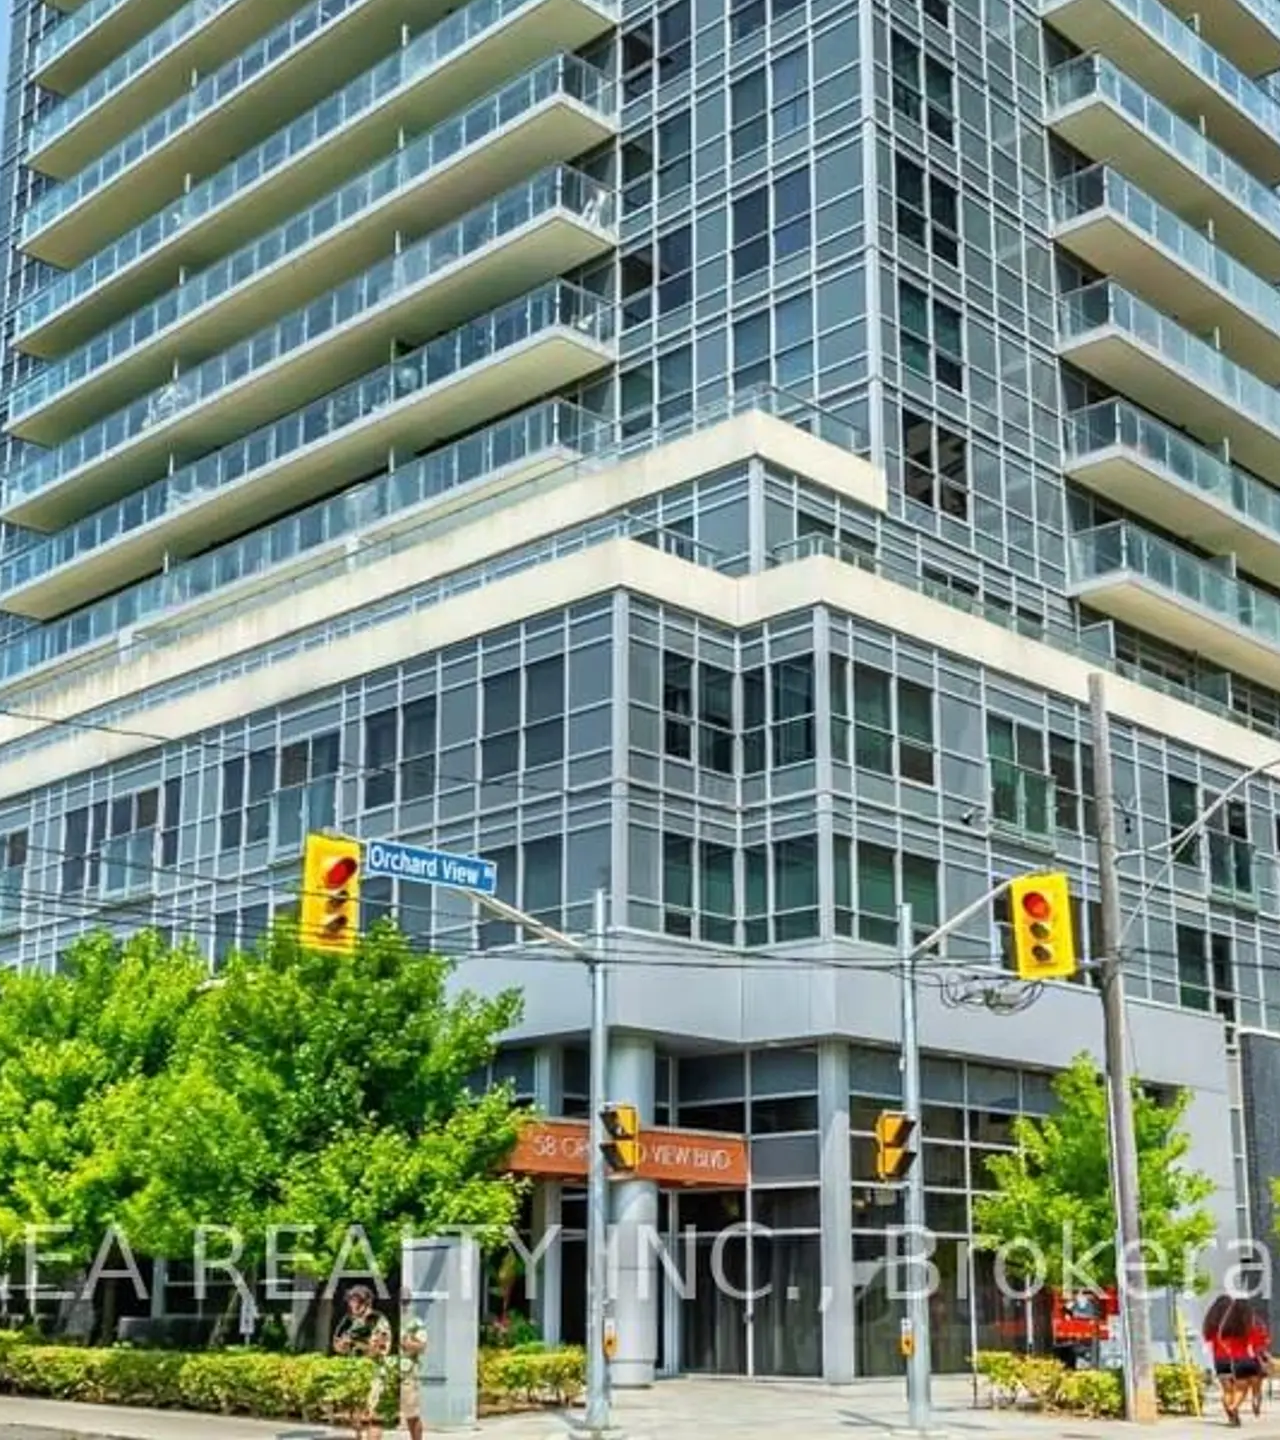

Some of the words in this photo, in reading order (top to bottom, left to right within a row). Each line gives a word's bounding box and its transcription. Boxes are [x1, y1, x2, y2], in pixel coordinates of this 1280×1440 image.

[371, 845, 438, 878] Orchard
[443, 858, 480, 885] View
[532, 1135, 557, 1157] 58
[652, 1142, 689, 1166] VIEW
